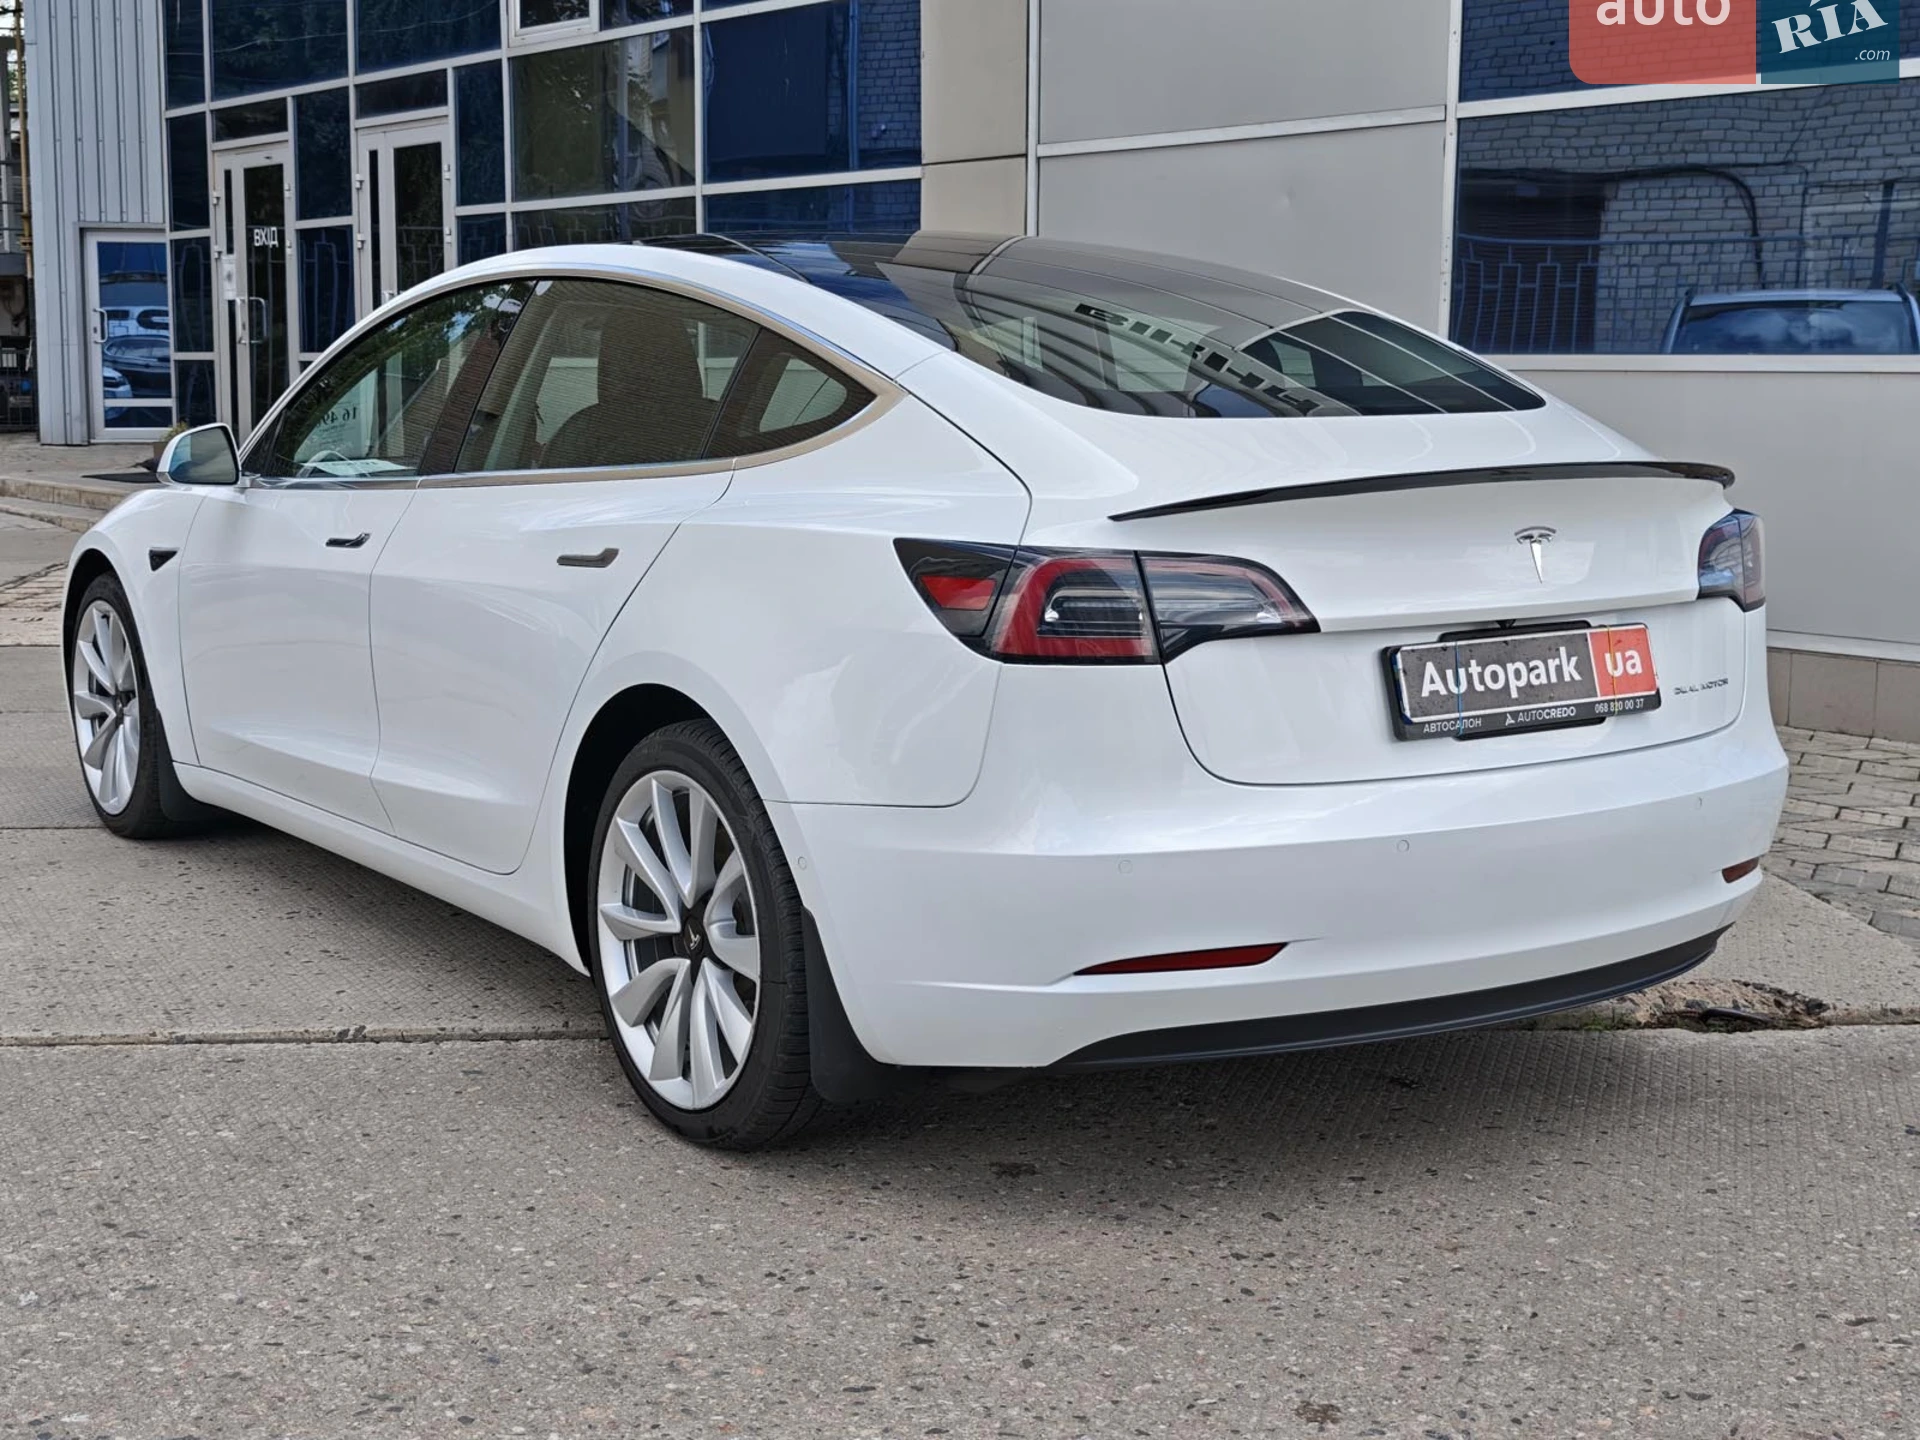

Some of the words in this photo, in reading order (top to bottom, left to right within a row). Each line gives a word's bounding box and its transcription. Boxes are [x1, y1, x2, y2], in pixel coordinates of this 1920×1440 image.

[253, 226, 279, 248] ВХІД
[1421, 647, 1582, 698] Autopark
[1605, 648, 1643, 677] ua
[1517, 706, 1577, 722] AUTOCREDO
[1423, 717, 1482, 733] АВТОСАЛОН
